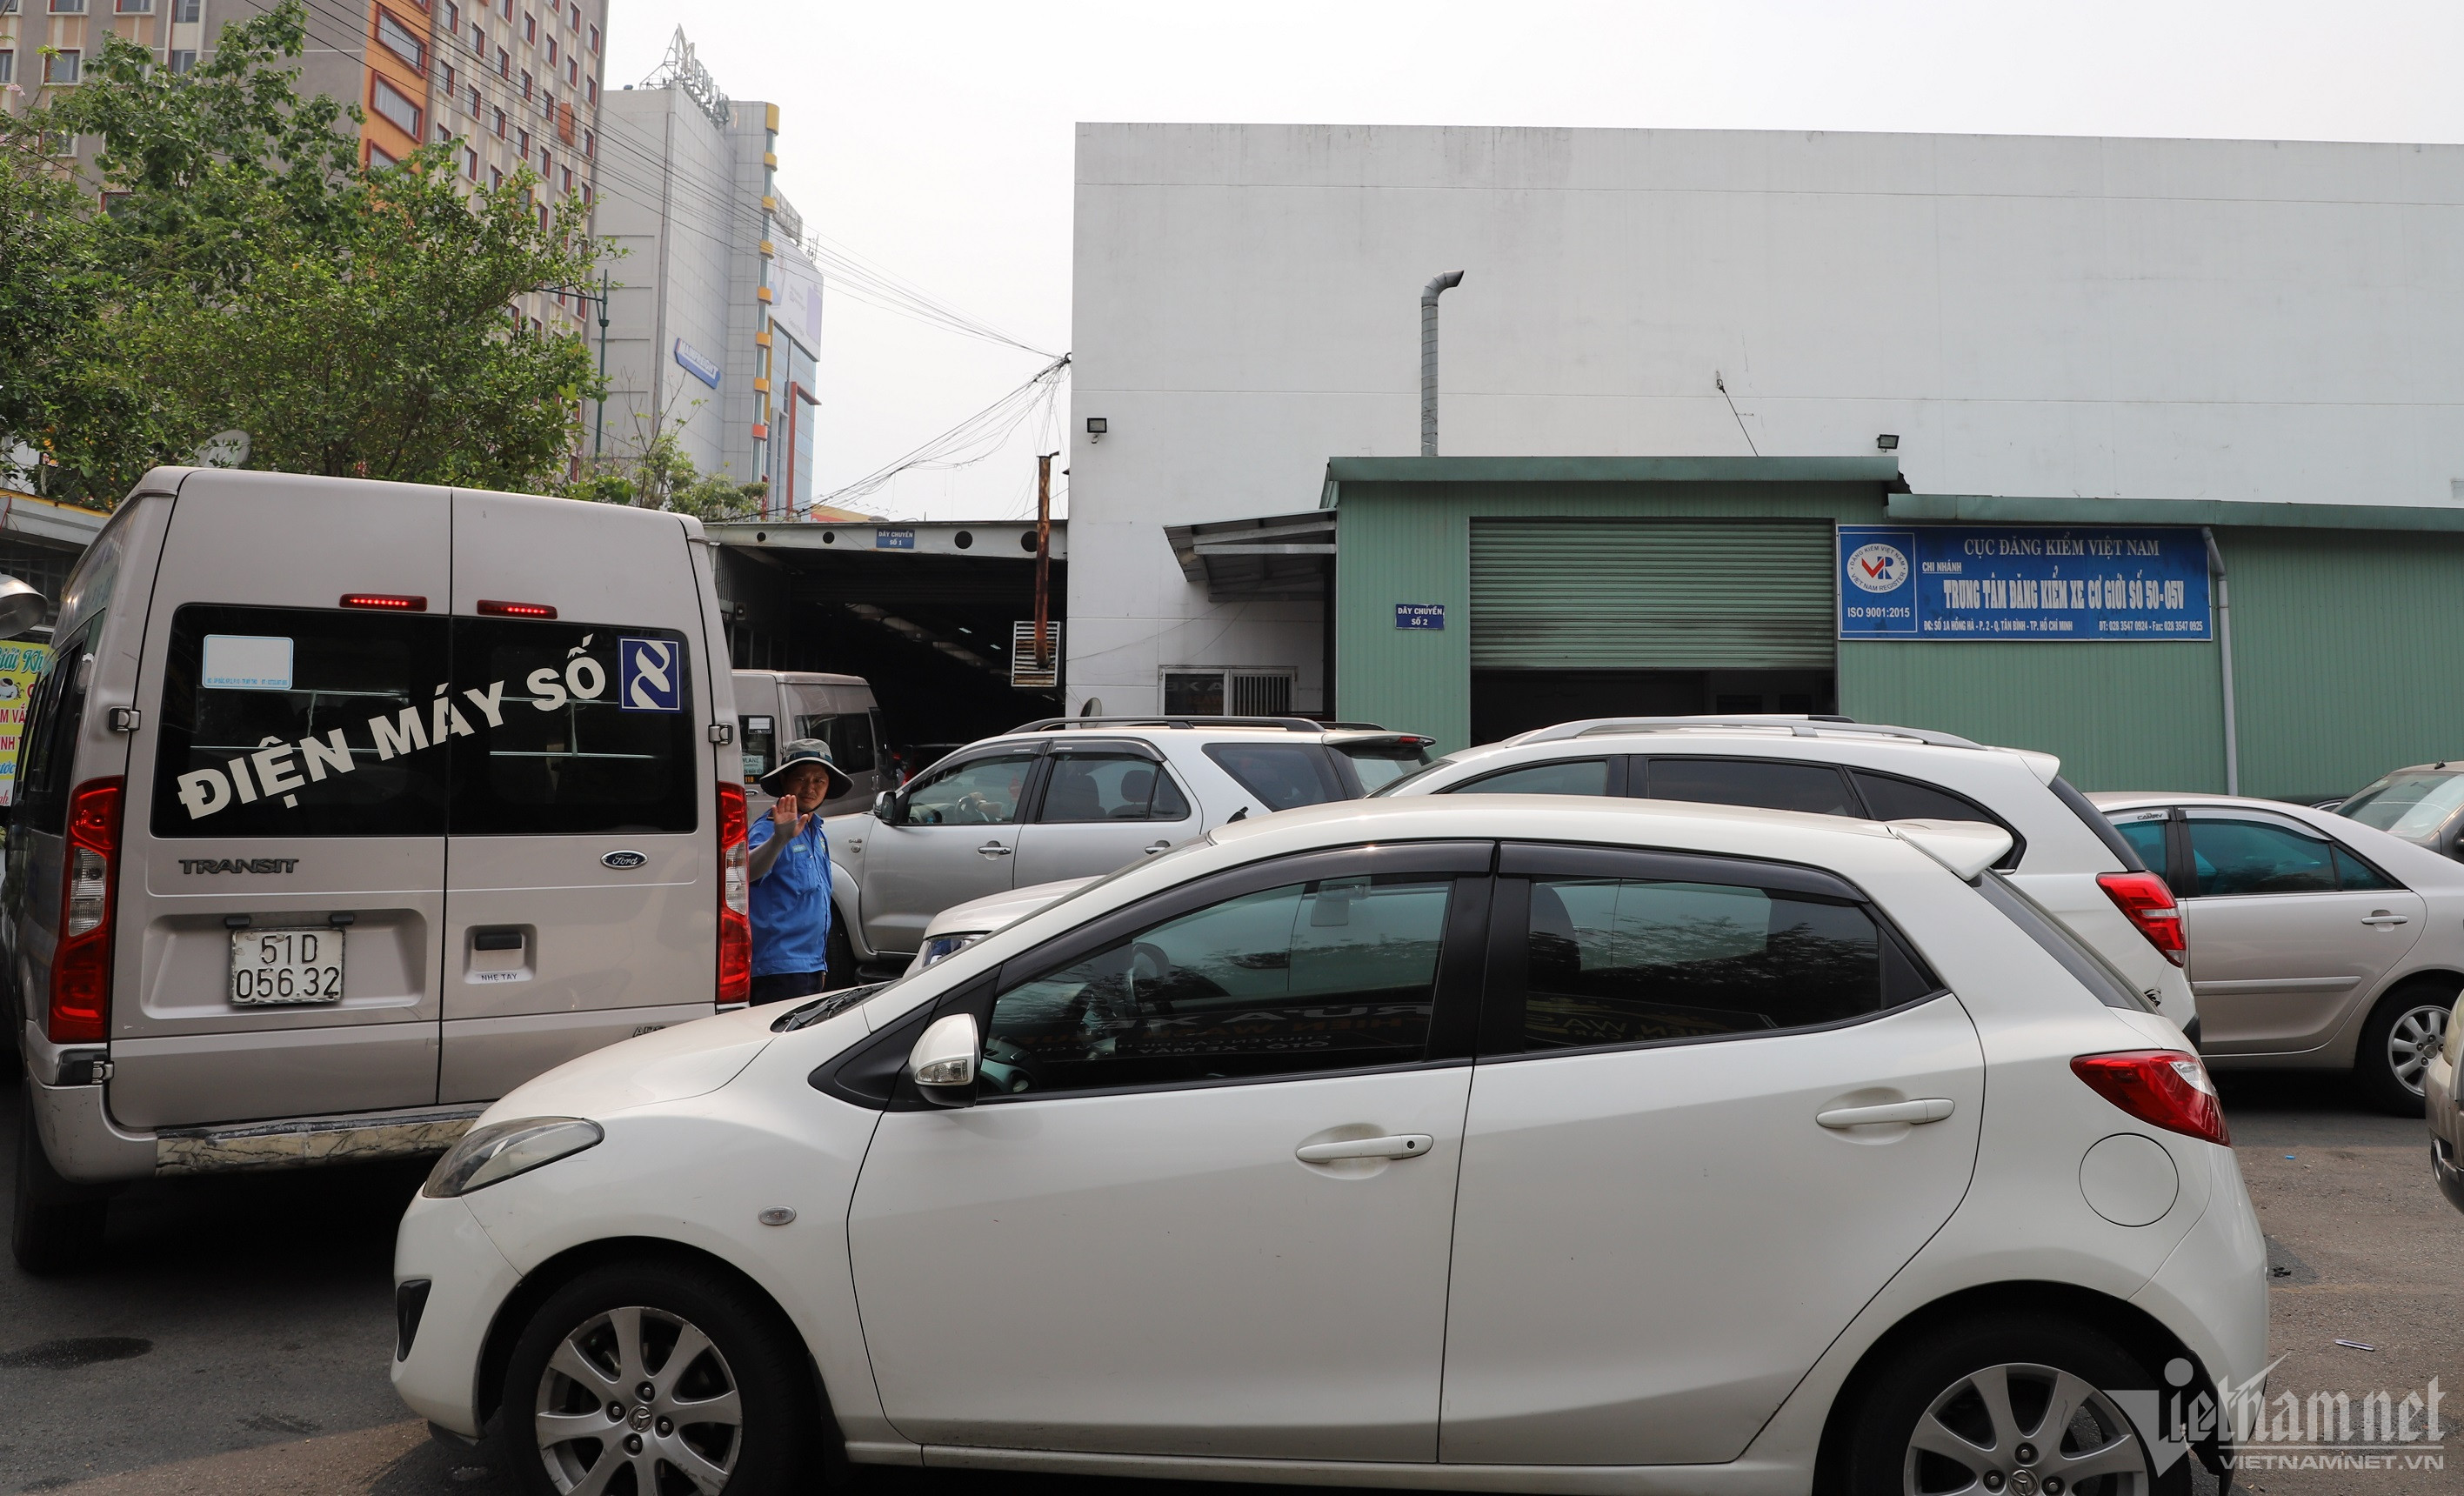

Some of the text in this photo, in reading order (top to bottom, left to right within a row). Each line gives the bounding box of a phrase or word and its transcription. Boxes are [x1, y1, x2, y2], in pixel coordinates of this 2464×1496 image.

[1964, 531, 2160, 559] CỤC ĐĂNG KIỂM VIỆT NAM
[1893, 552, 1906, 566] NAM
[1922, 559, 1962, 572] CHI NHÁNH
[1863, 583, 1878, 591] NAM
[1879, 571, 1906, 591] REGISTER
[1943, 579, 1980, 609] TRUNG
[1982, 571, 2007, 609] TÂM
[2040, 565, 2068, 609] KIỂM
[2070, 580, 2085, 609] XE
[2087, 574, 2102, 609] CƠ
[2105, 572, 2127, 609] GIỚI
[2128, 569, 2144, 609] SỐ
[2145, 580, 2185, 610] 50-05V
[1398, 606, 1412, 615] DÂY
[1847, 607, 1910, 618] ISO 9001:2015
[1411, 616, 1422, 625] SỐ
[1933, 617, 1942, 631] SỐ
[1943, 621, 1951, 631] 1A
[1951, 617, 1967, 631] HỒNG
[1967, 618, 1974, 631] HÀ
[1979, 621, 1985, 631] P.
[1986, 621, 1990, 631] 2
[1993, 621, 2000, 632] Q.
[2000, 618, 2012, 631] TÂN
[2012, 618, 2026, 631] BÌNH
[2030, 621, 2039, 631] TP.
[2040, 617, 2047, 631] HỒ
[2048, 618, 2059, 631] CHÍ
[2059, 621, 2073, 631] MINH
[2099, 621, 2108, 631] ĐT:
[2108, 621, 2120, 631] 028
[2120, 621, 2133, 631] 3547
[2164, 621, 2174, 631] 028
[2175, 621, 2188, 631] 3547
[12, 703, 28, 723] VẮ
[177, 633, 606, 820] ĐIỆN MÁY SỐ
[178, 858, 299, 874] TRANSIT
[611, 853, 638, 865] Ford
[236, 966, 340, 999] 056.32
[481, 972, 518, 982] NHẸ TAY
